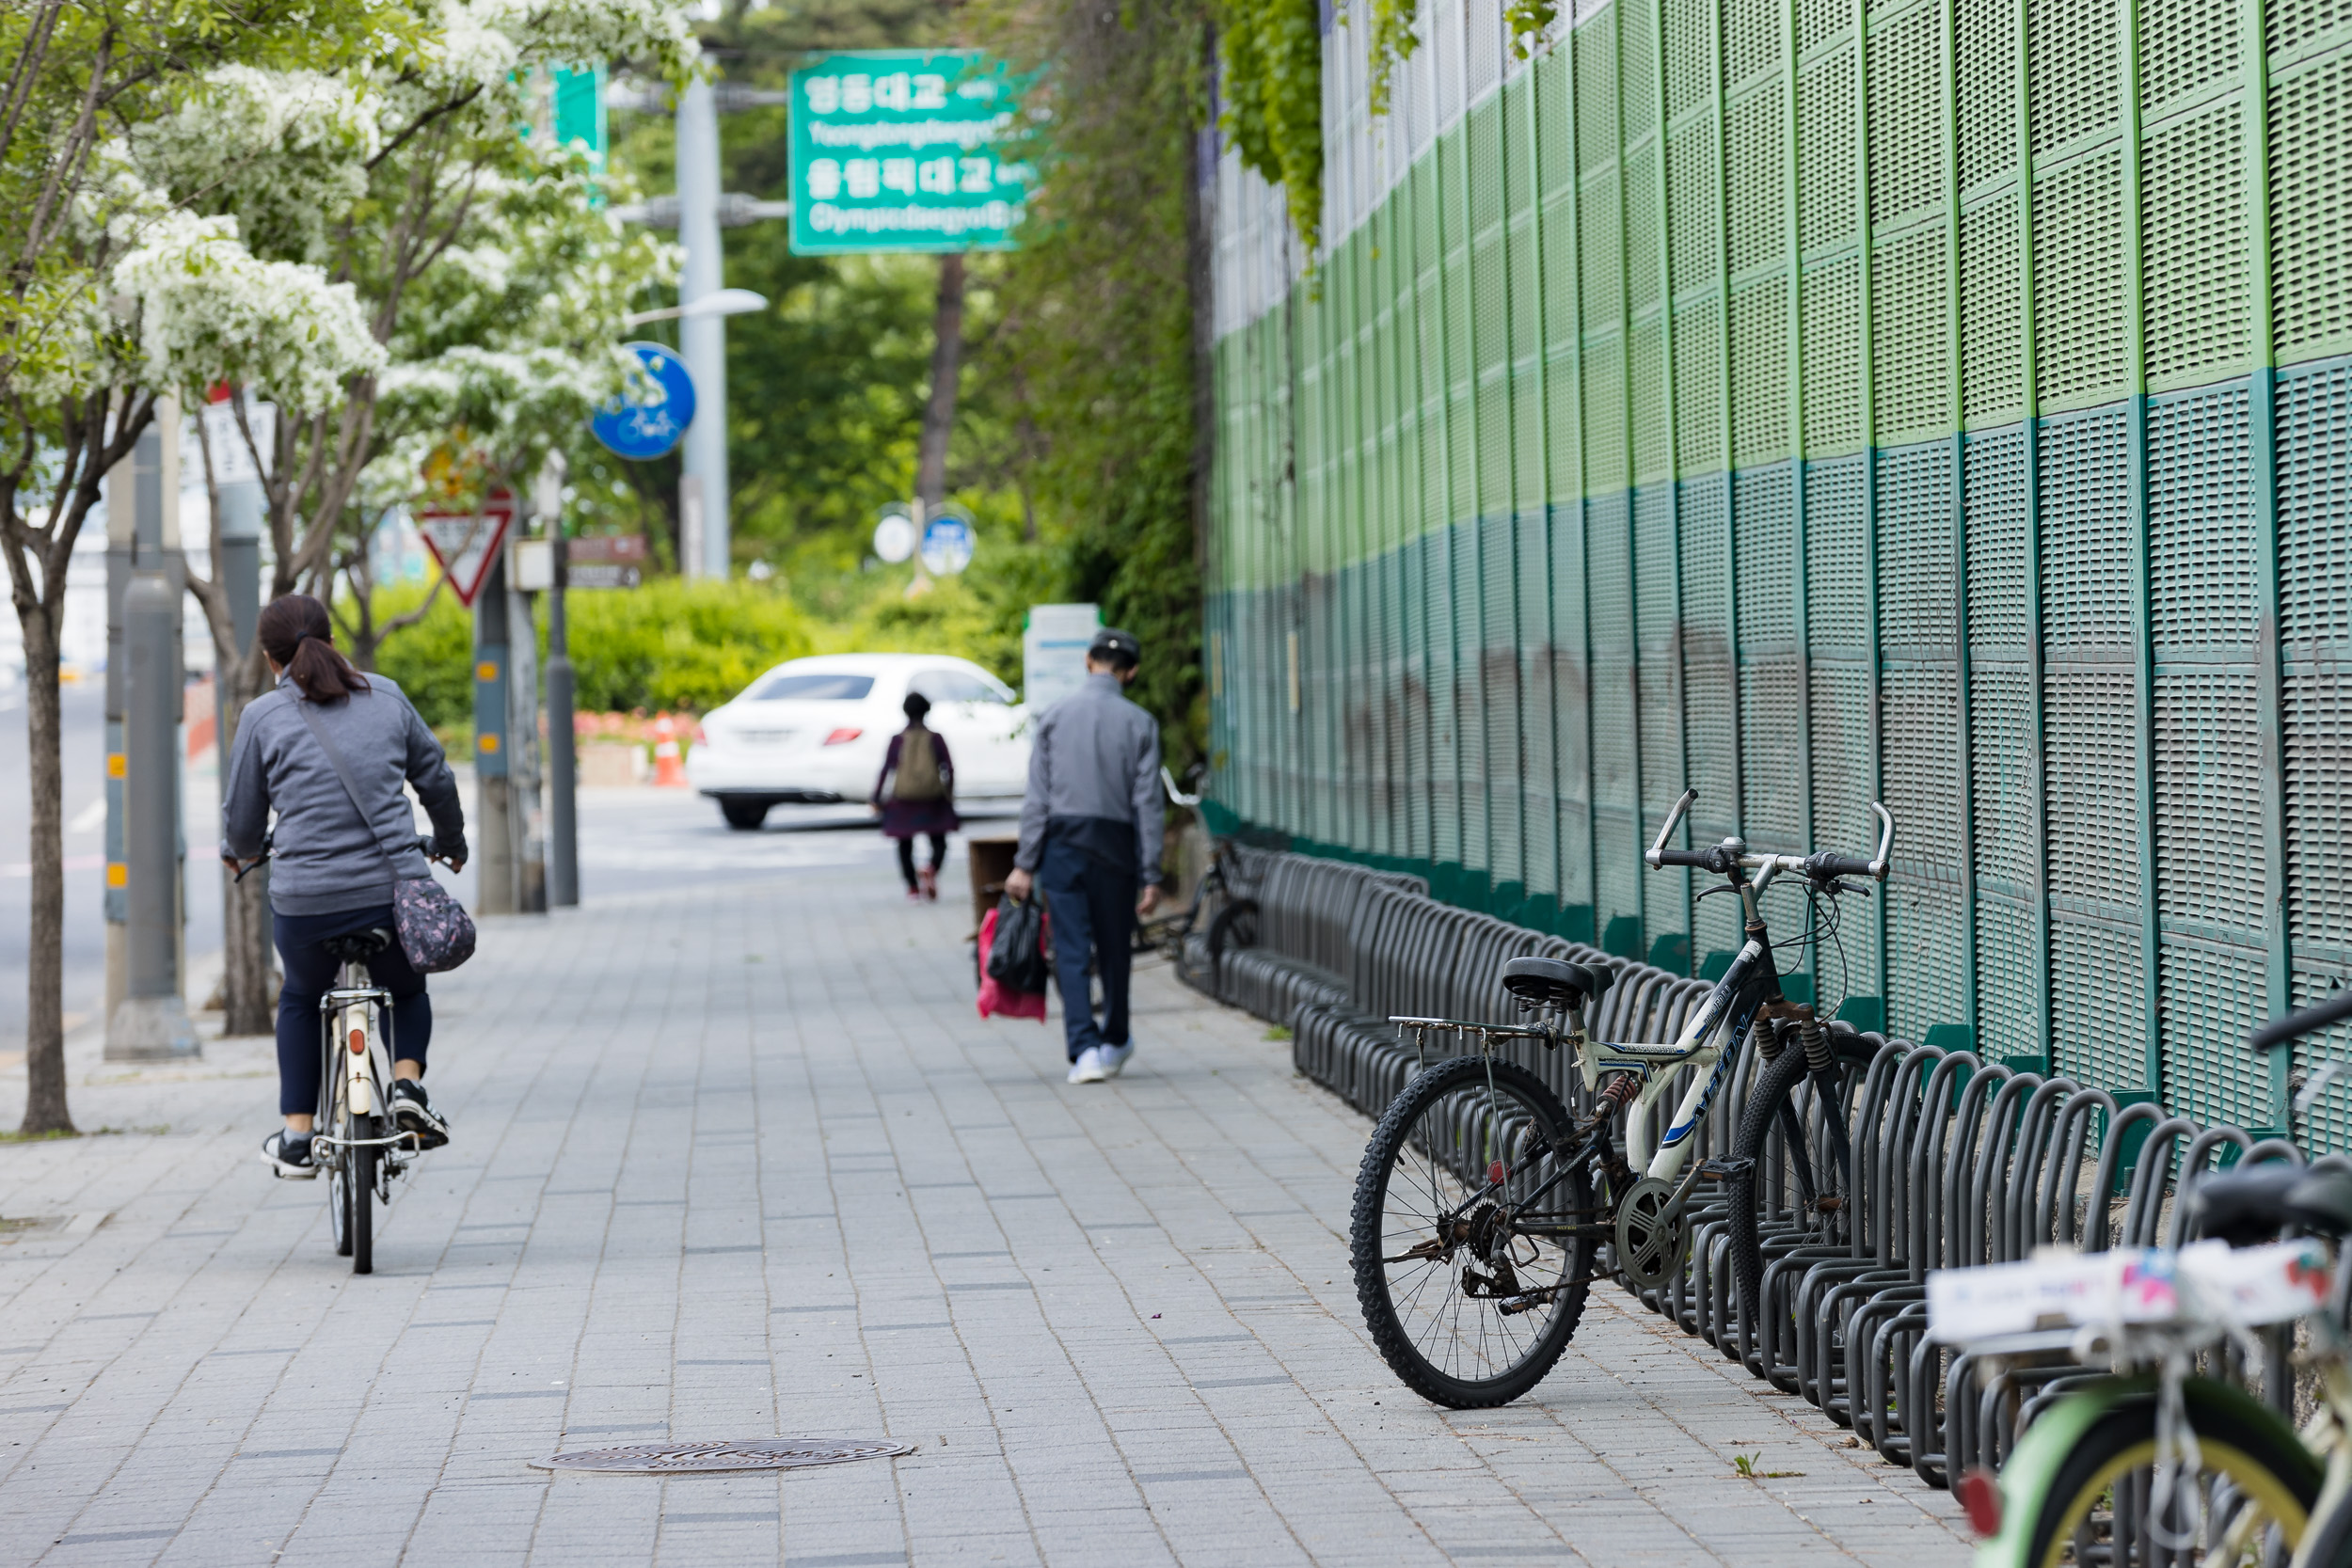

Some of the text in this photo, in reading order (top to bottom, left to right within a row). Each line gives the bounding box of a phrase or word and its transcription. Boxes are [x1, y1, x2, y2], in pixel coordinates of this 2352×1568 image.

[804, 72, 948, 114] 영동대교
[806, 156, 993, 199] 올림픽대교
[1693, 1014, 1749, 1127] ALTON
